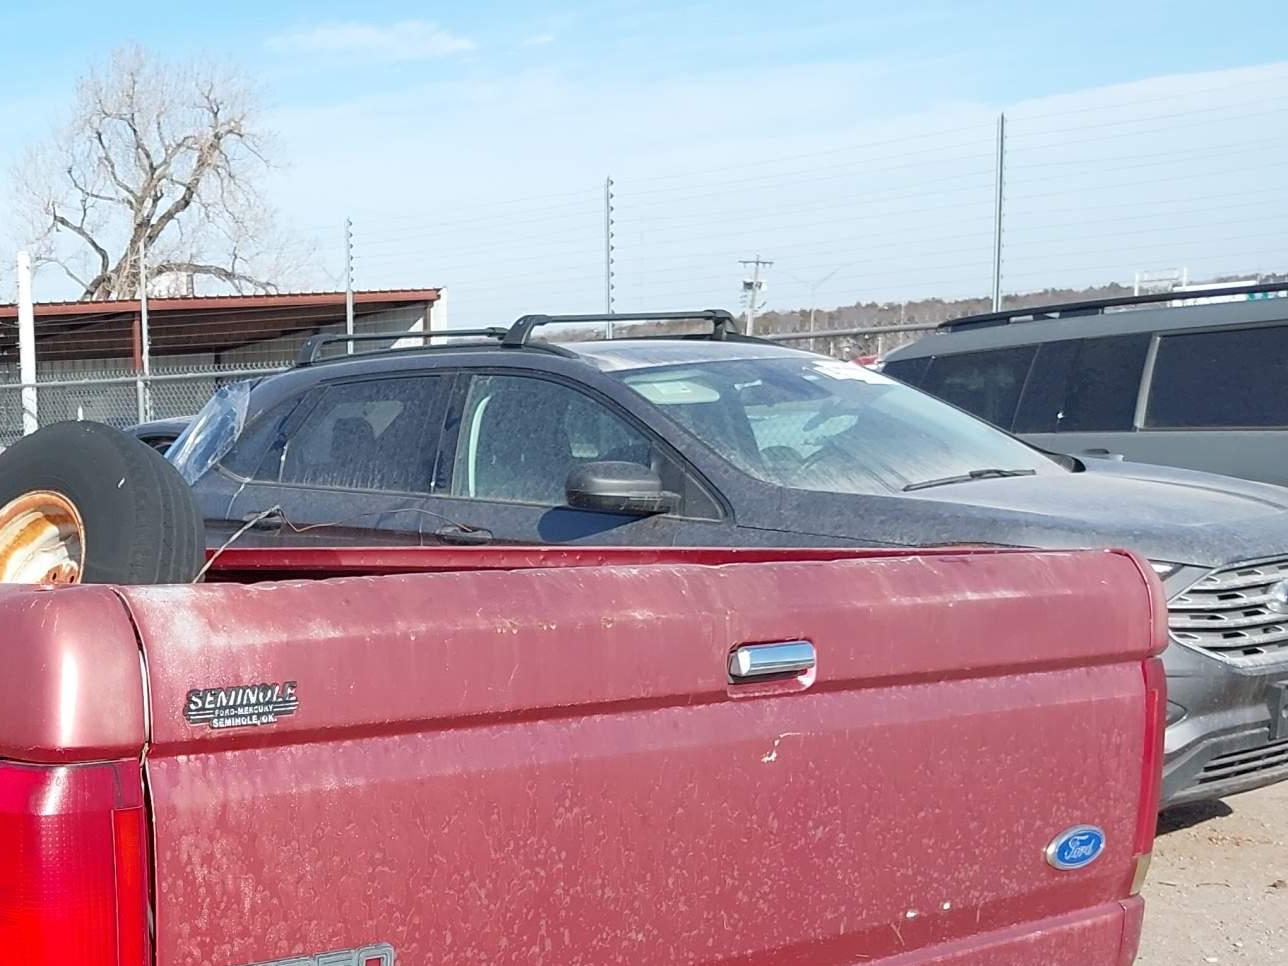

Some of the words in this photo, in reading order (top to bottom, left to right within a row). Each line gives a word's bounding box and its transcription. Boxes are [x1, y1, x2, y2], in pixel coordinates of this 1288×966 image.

[187, 681, 298, 711] SEMINOLE
[214, 704, 274, 717] FORD-MERCURY
[1063, 834, 1096, 860] Ford
